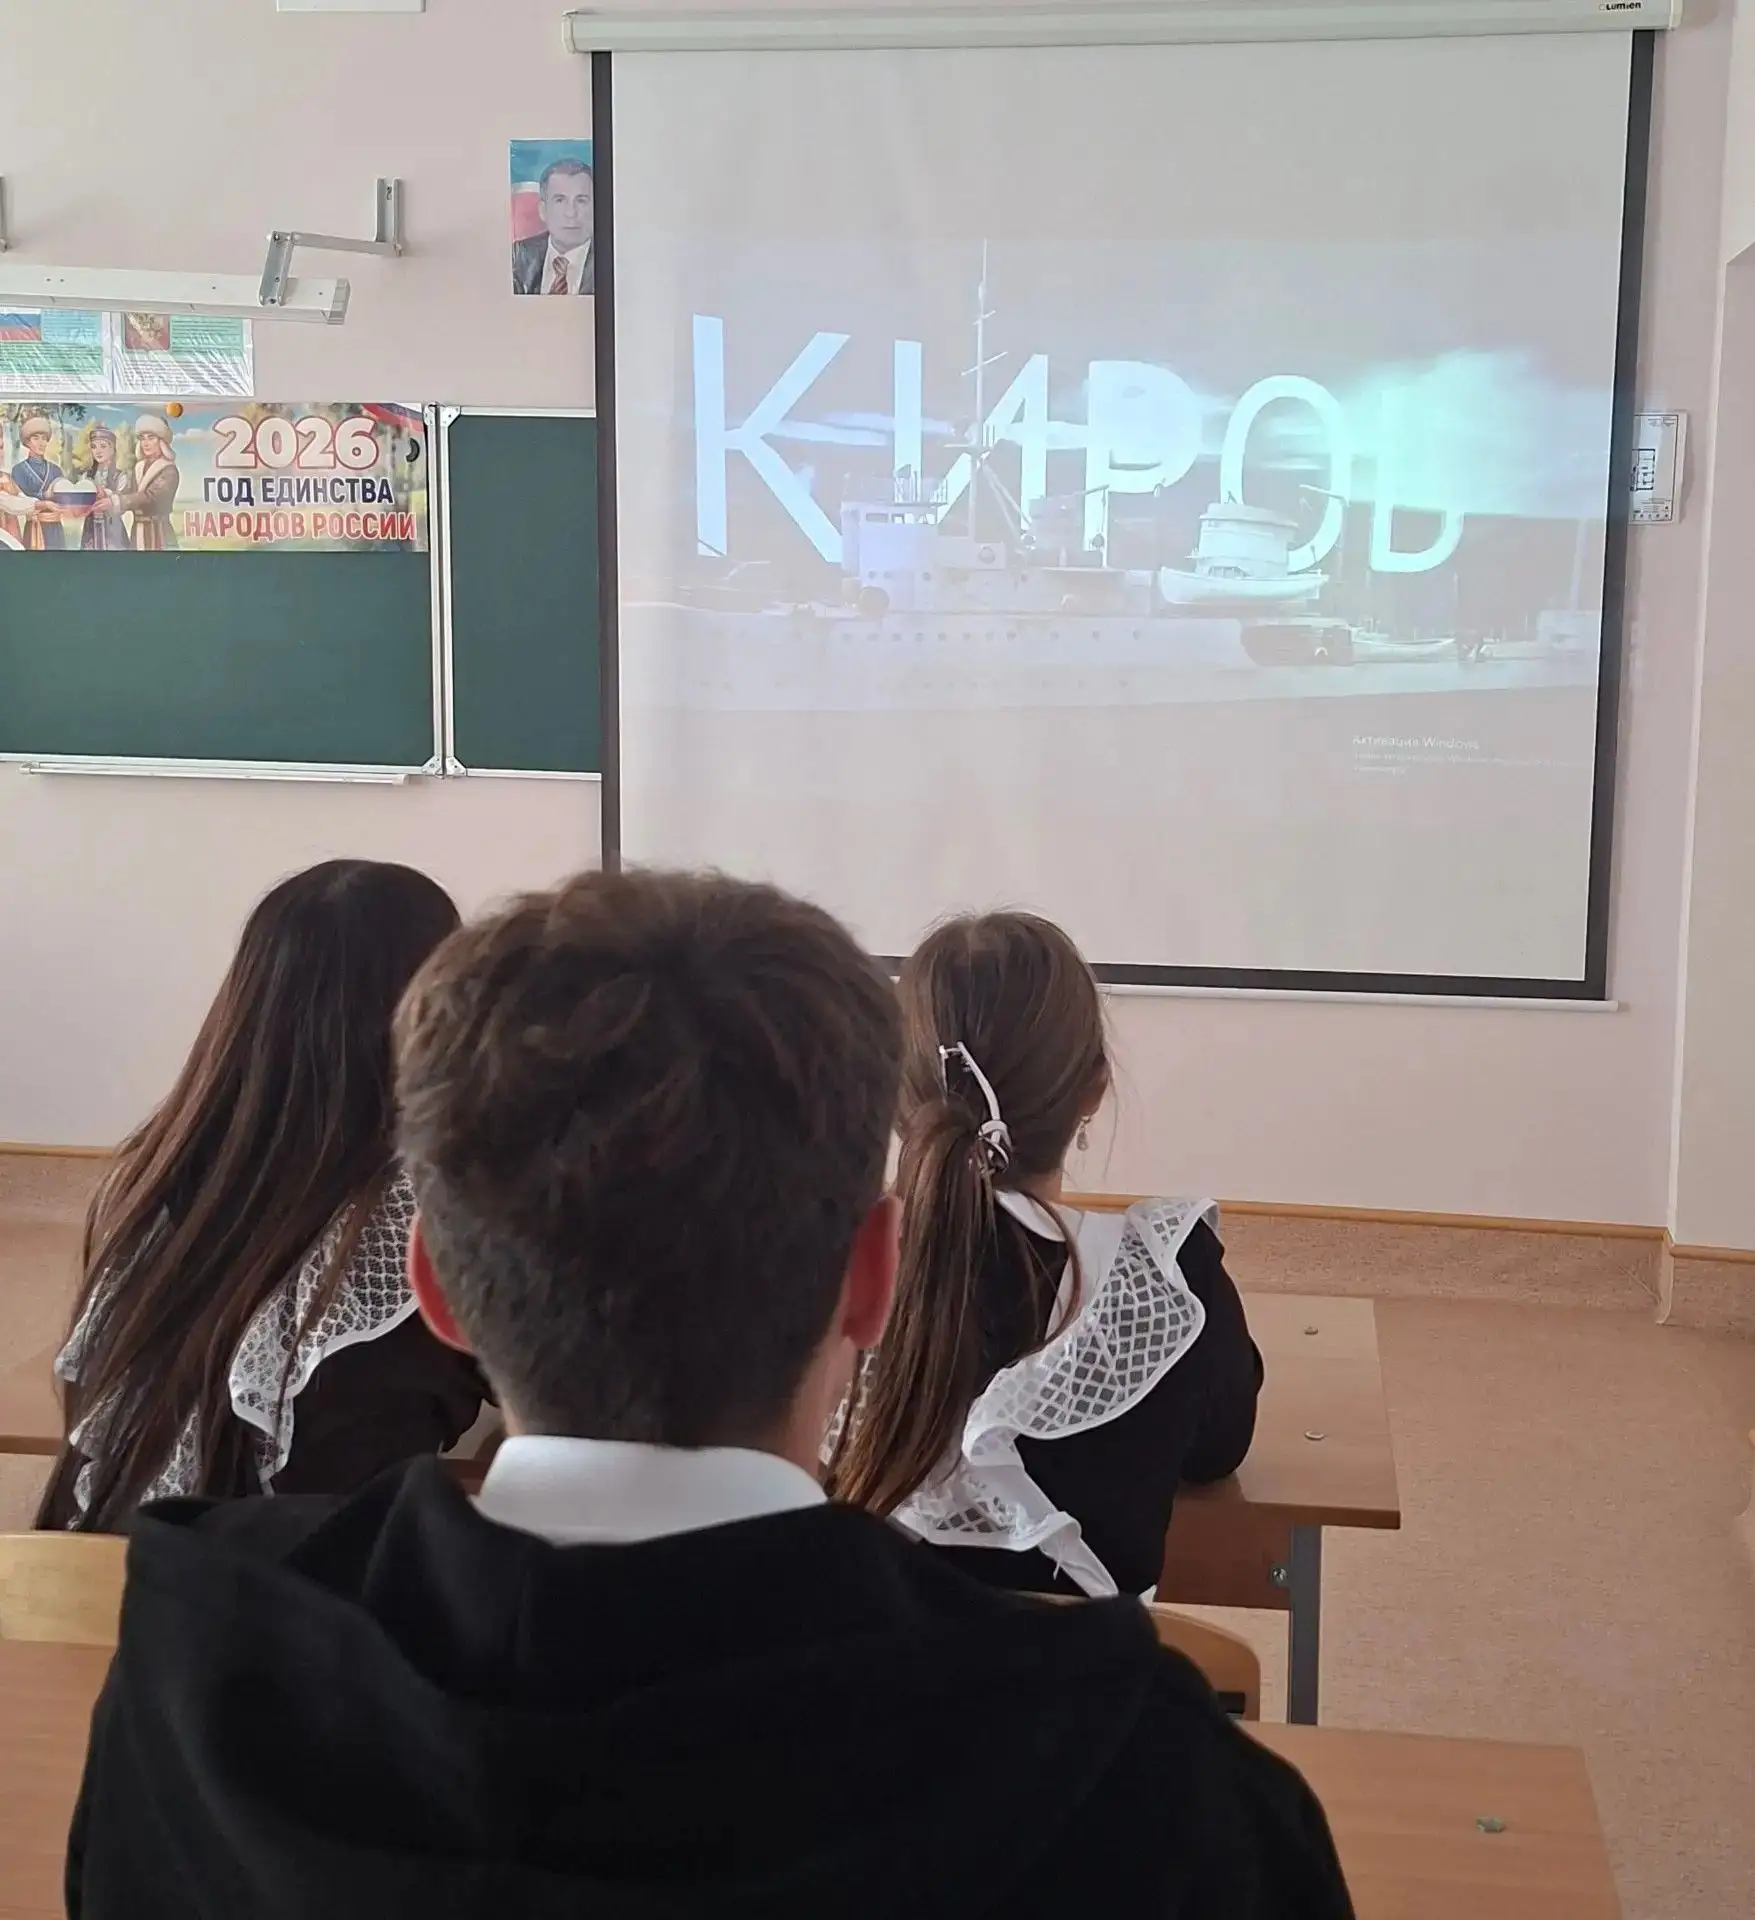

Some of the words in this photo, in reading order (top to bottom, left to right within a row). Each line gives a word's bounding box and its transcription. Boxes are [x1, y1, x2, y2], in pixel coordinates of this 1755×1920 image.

[1605, 2, 1642, 11] Lumien
[212, 415, 379, 471] 2026
[203, 477, 255, 507] ГОД
[261, 477, 394, 507] ЕДИНСТВА
[185, 511, 305, 541] НАРОДОВ
[312, 512, 416, 540] РОССИИ
